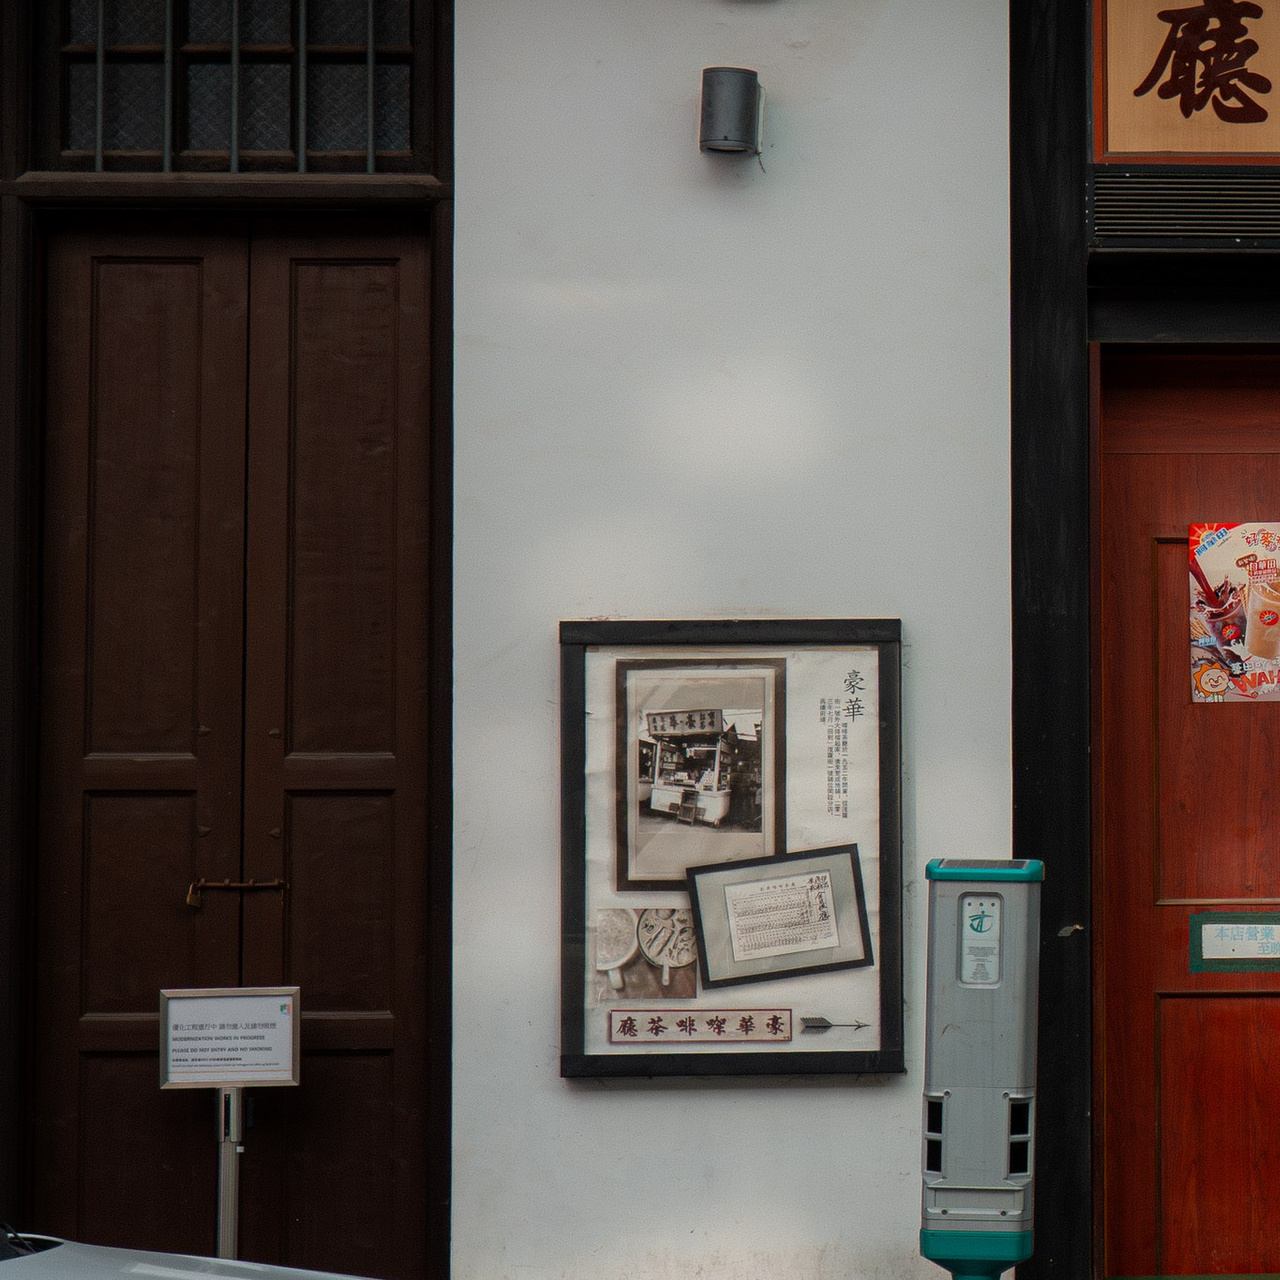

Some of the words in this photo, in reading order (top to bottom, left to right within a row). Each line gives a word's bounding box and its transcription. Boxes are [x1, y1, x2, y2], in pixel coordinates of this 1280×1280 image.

[842, 669, 866, 722] 豪華
[1214, 926, 1276, 942] 本店營業
